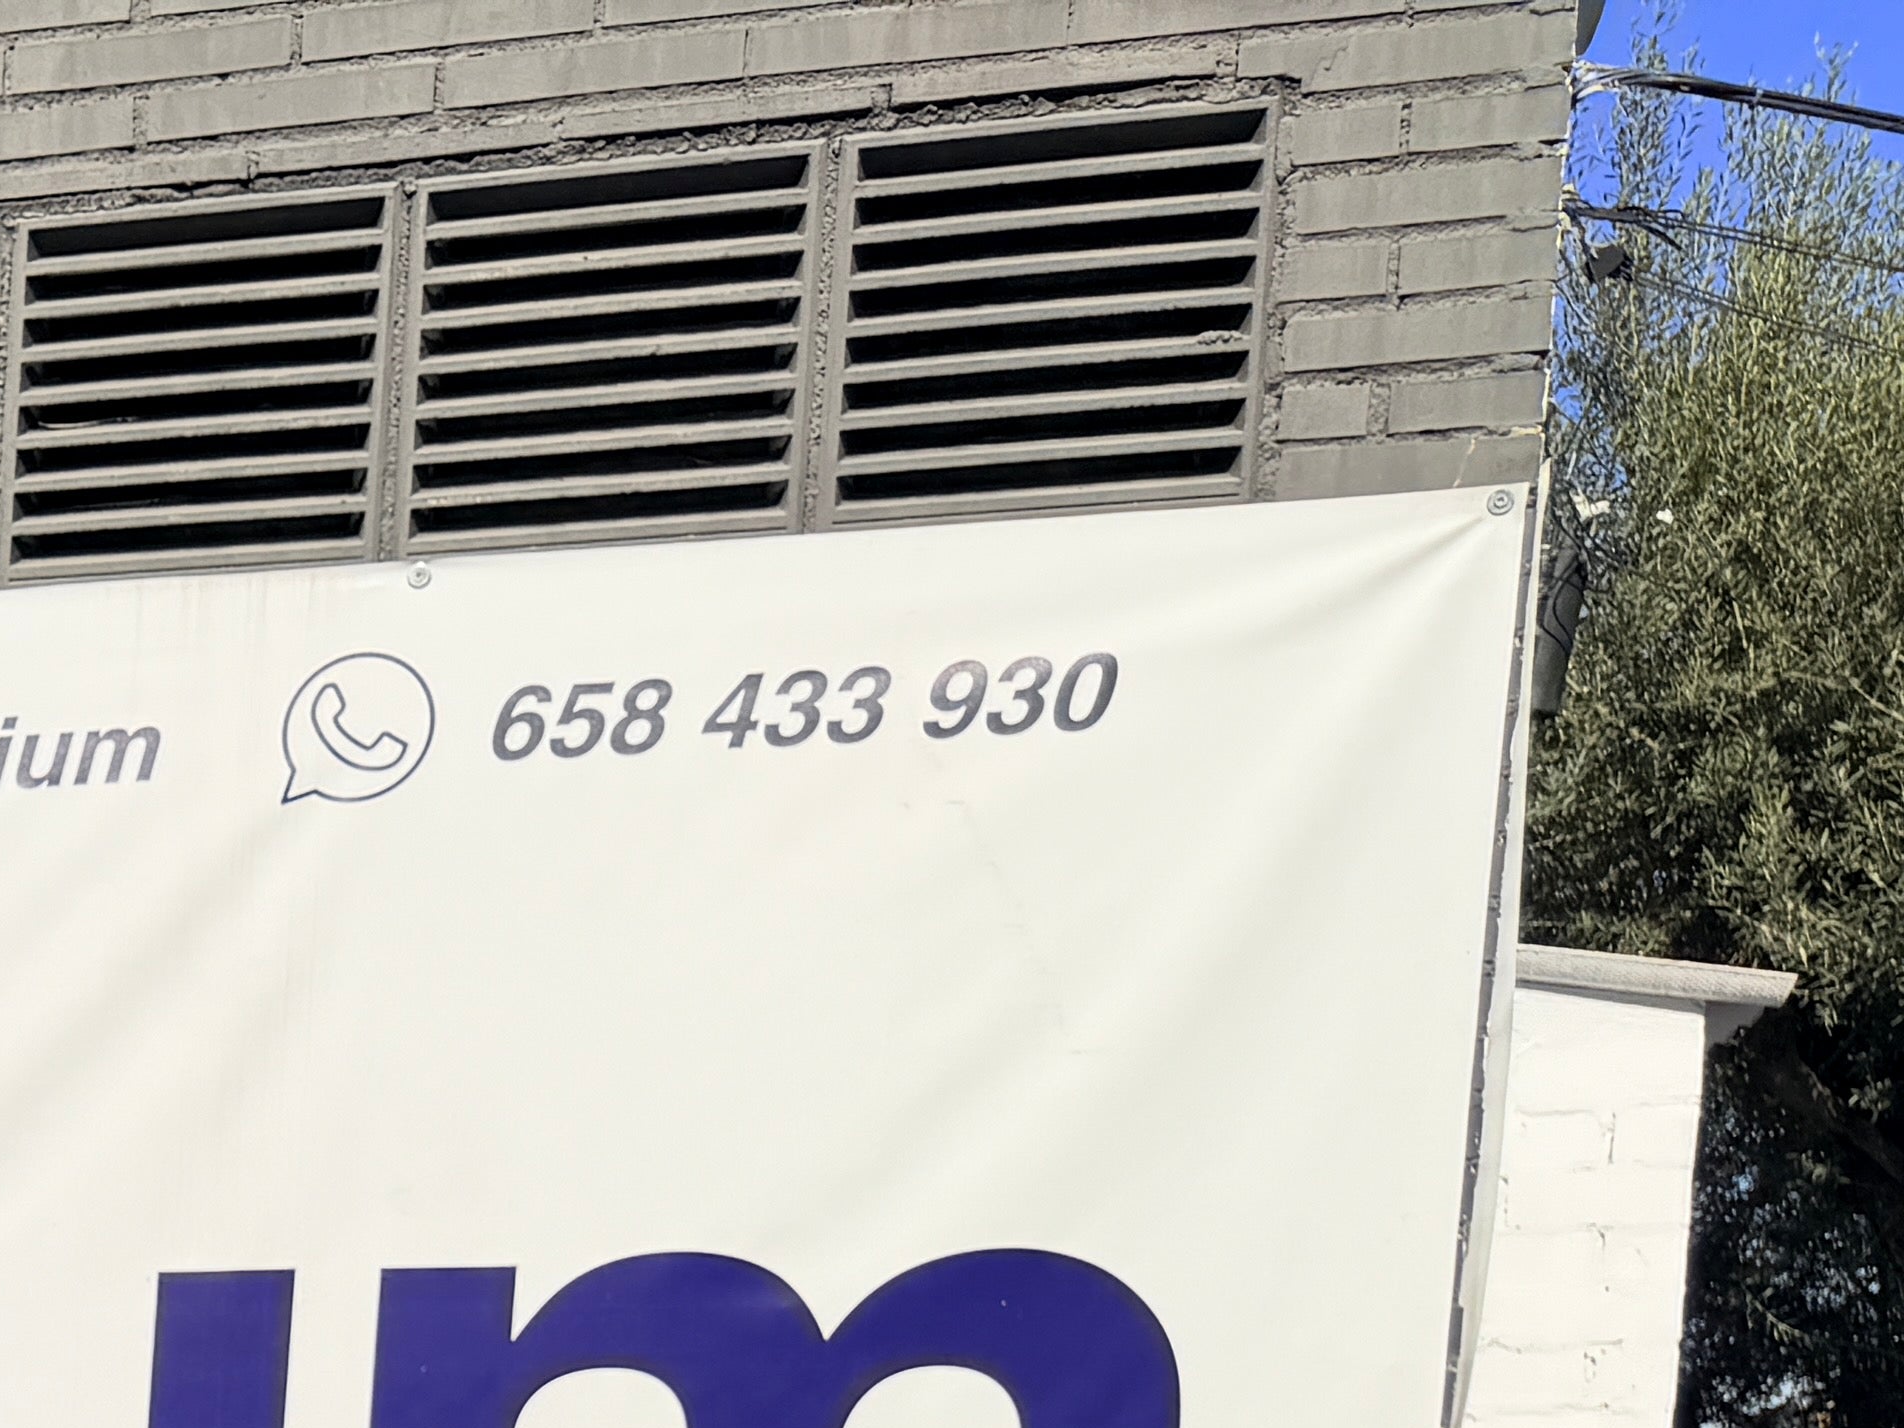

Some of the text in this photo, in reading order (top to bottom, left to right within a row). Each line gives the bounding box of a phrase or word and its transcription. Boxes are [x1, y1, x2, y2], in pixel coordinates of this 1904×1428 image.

[490, 652, 1120, 762] 658 433 930
